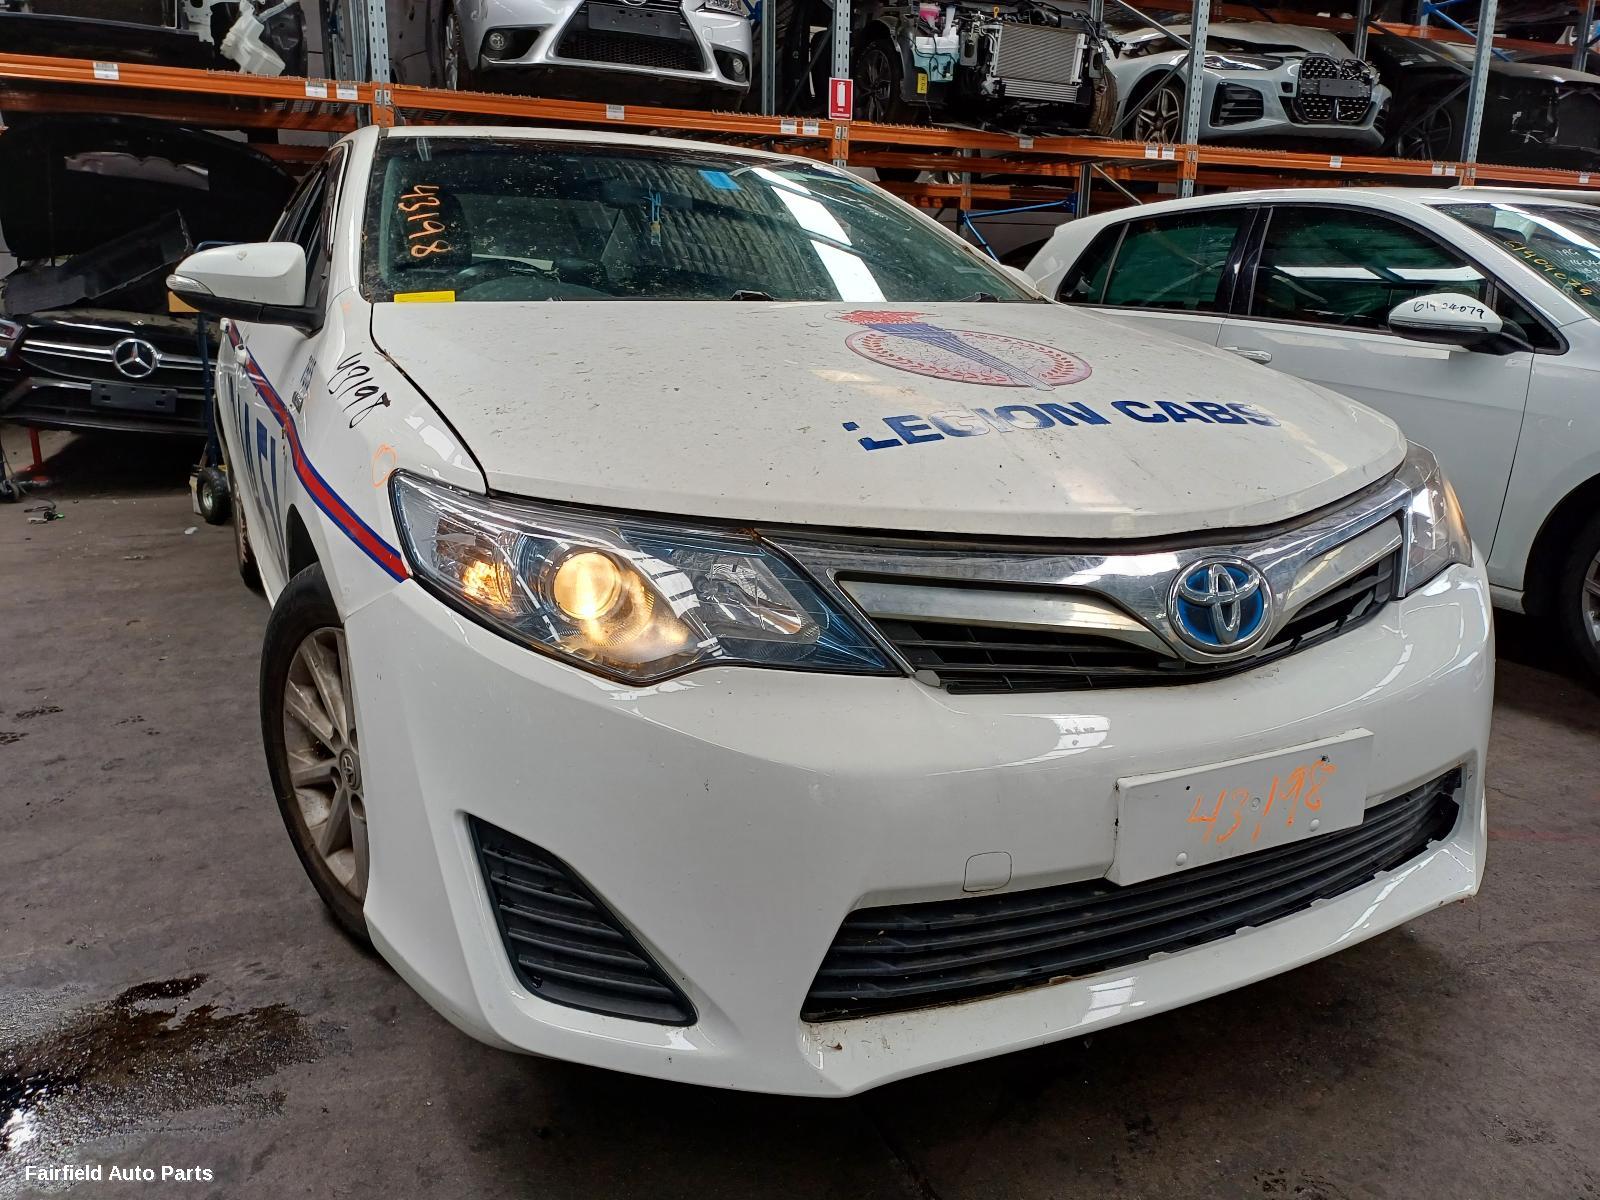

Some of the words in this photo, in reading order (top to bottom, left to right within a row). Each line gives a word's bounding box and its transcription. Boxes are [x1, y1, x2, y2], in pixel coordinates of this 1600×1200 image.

[398, 184, 451, 258] 43198
[326, 352, 391, 429] 43198
[842, 401, 1112, 452] LEGION
[1110, 400, 1282, 428] CABS
